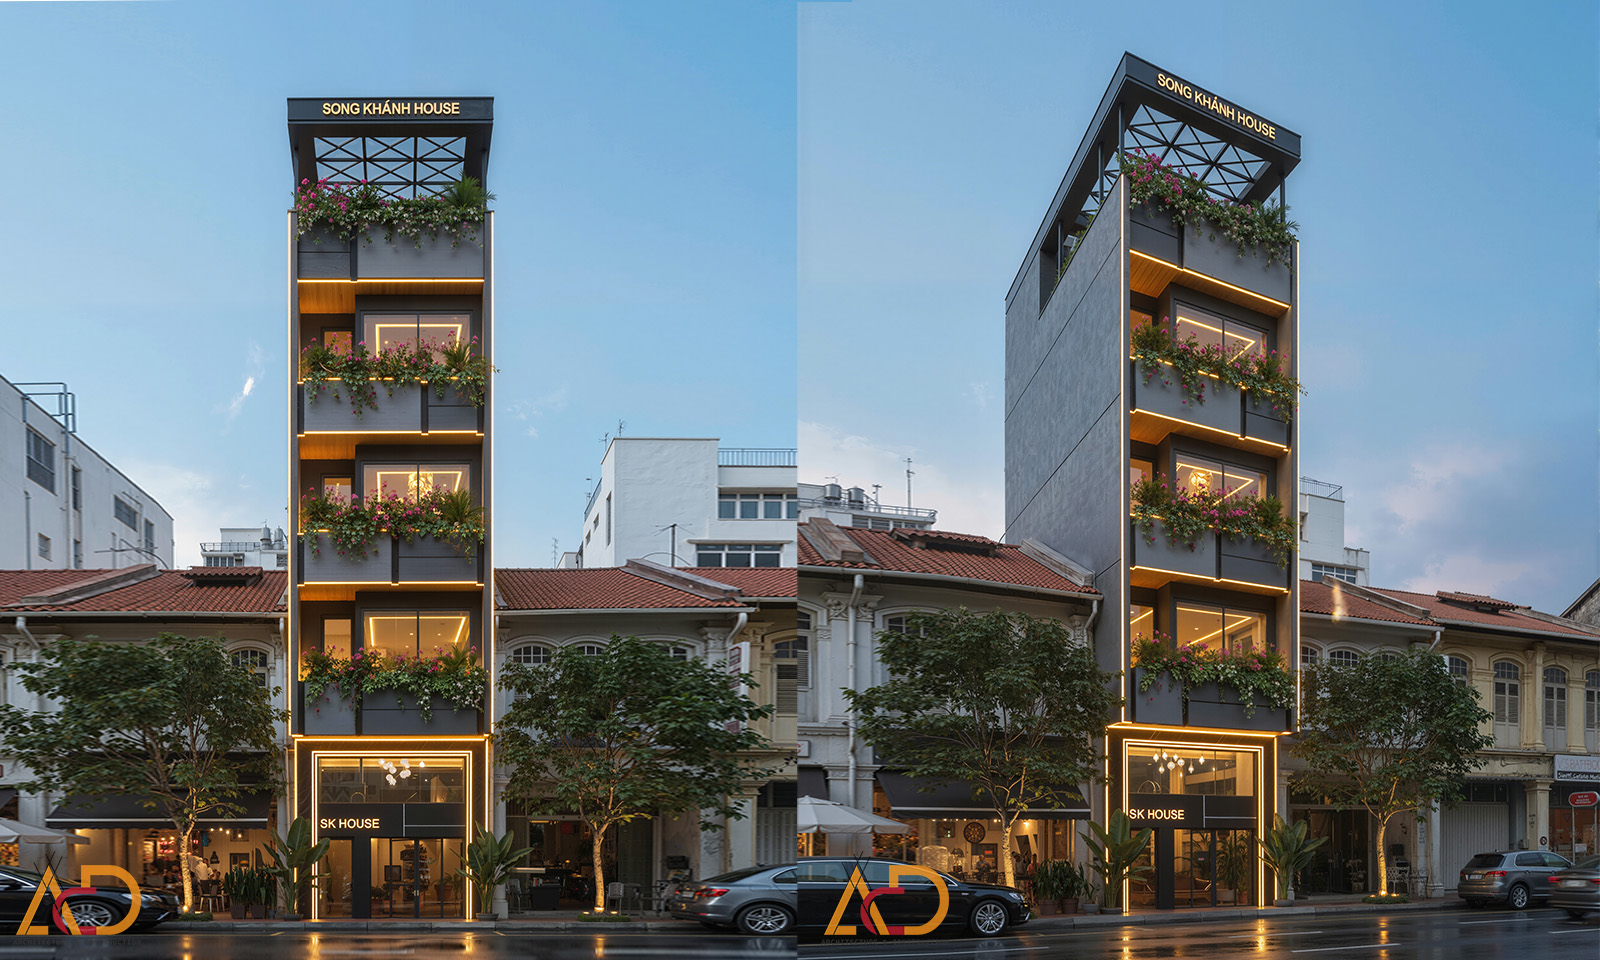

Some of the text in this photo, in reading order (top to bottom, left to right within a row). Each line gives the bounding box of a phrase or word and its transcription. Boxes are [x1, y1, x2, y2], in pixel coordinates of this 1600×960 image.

[322, 99, 460, 115] SONG KHÁNH HOUSE
[1157, 73, 1276, 140] SONG KHÁNH HOUSE
[1129, 808, 1185, 820] SK HOUSE
[320, 818, 380, 829] SK HOUSE
